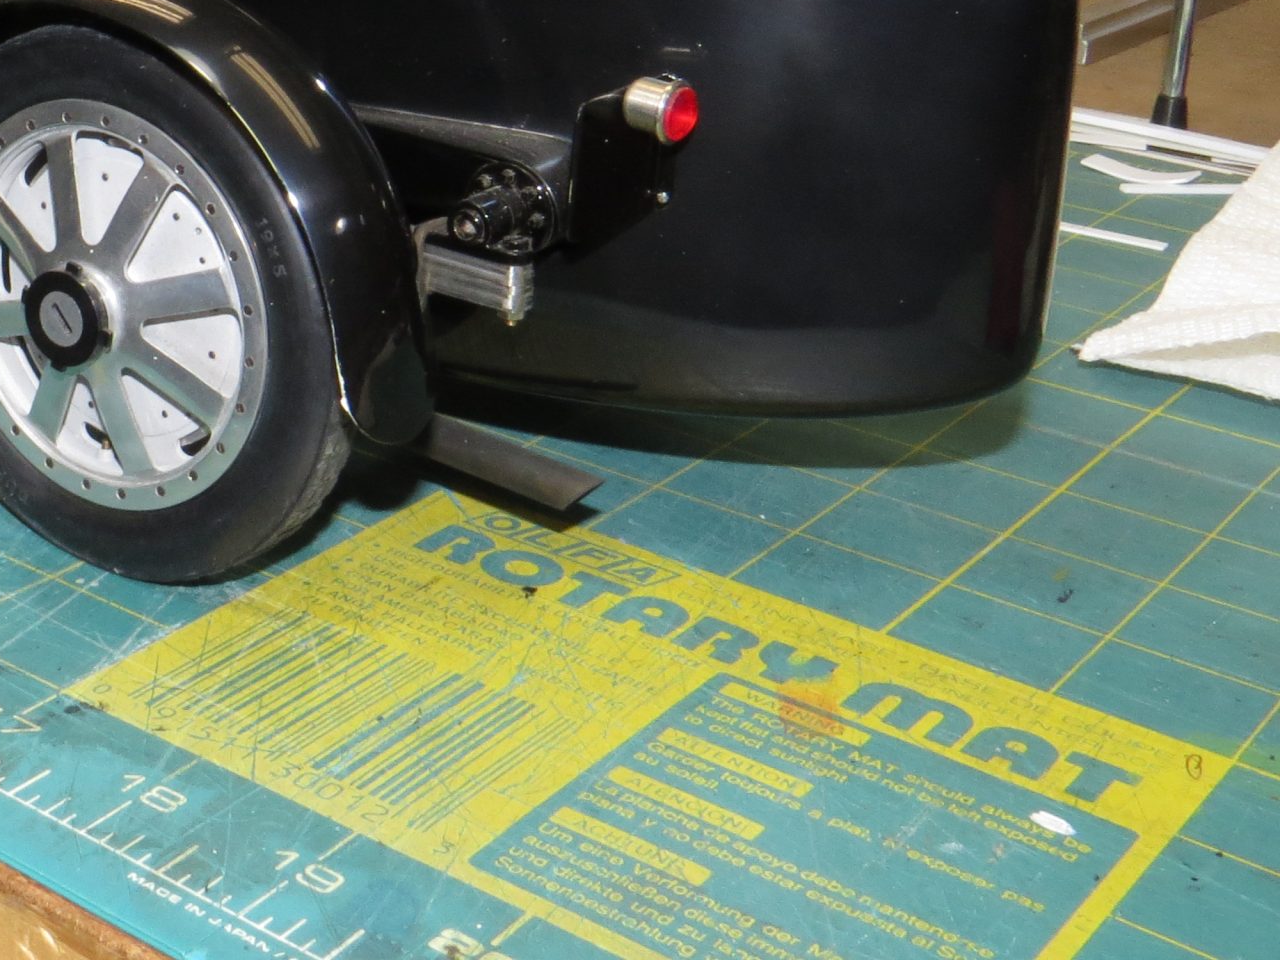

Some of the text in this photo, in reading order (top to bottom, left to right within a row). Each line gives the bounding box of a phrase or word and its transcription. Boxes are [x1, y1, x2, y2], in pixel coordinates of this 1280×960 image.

[482, 514, 659, 583] OLFA
[413, 525, 1144, 803] ROTARY MAT
[746, 691, 845, 736] WARNING
[633, 750, 660, 767] au
[683, 713, 703, 726] to
[708, 723, 763, 749] direct
[711, 695, 1092, 853] The ROTARY MAT should always be
[120, 773, 188, 815] 18
[647, 741, 715, 773] Garder
[720, 770, 802, 811] toujours
[1001, 890, 1045, 913] pas
[695, 703, 1079, 863] kept flat and should not be left exposed
[127, 871, 270, 952] MADE IN JAPAN
[272, 848, 346, 895] 19
[494, 855, 697, 959] Sonnenbestrahlung
[508, 844, 550, 868] und
[552, 865, 625, 903] direkte
[630, 900, 675, 927] und
[677, 922, 707, 943] zu
[538, 821, 800, 946] Um eine Verformung der
[577, 790, 636, 821] plana
[641, 817, 660, 830] y
[662, 826, 690, 843] no
[692, 840, 746, 868] debe
[748, 864, 805, 892] estar
[806, 888, 908, 938] expuesta
[911, 934, 936, 950] al
[593, 781, 618, 797] La
[619, 792, 700, 831] plancha
[703, 826, 732, 843] de
[732, 840, 798, 874] apoyo
[800, 869, 856, 898] debe
[857, 894, 995, 959] mantenerse
[683, 907, 744, 940] diese
